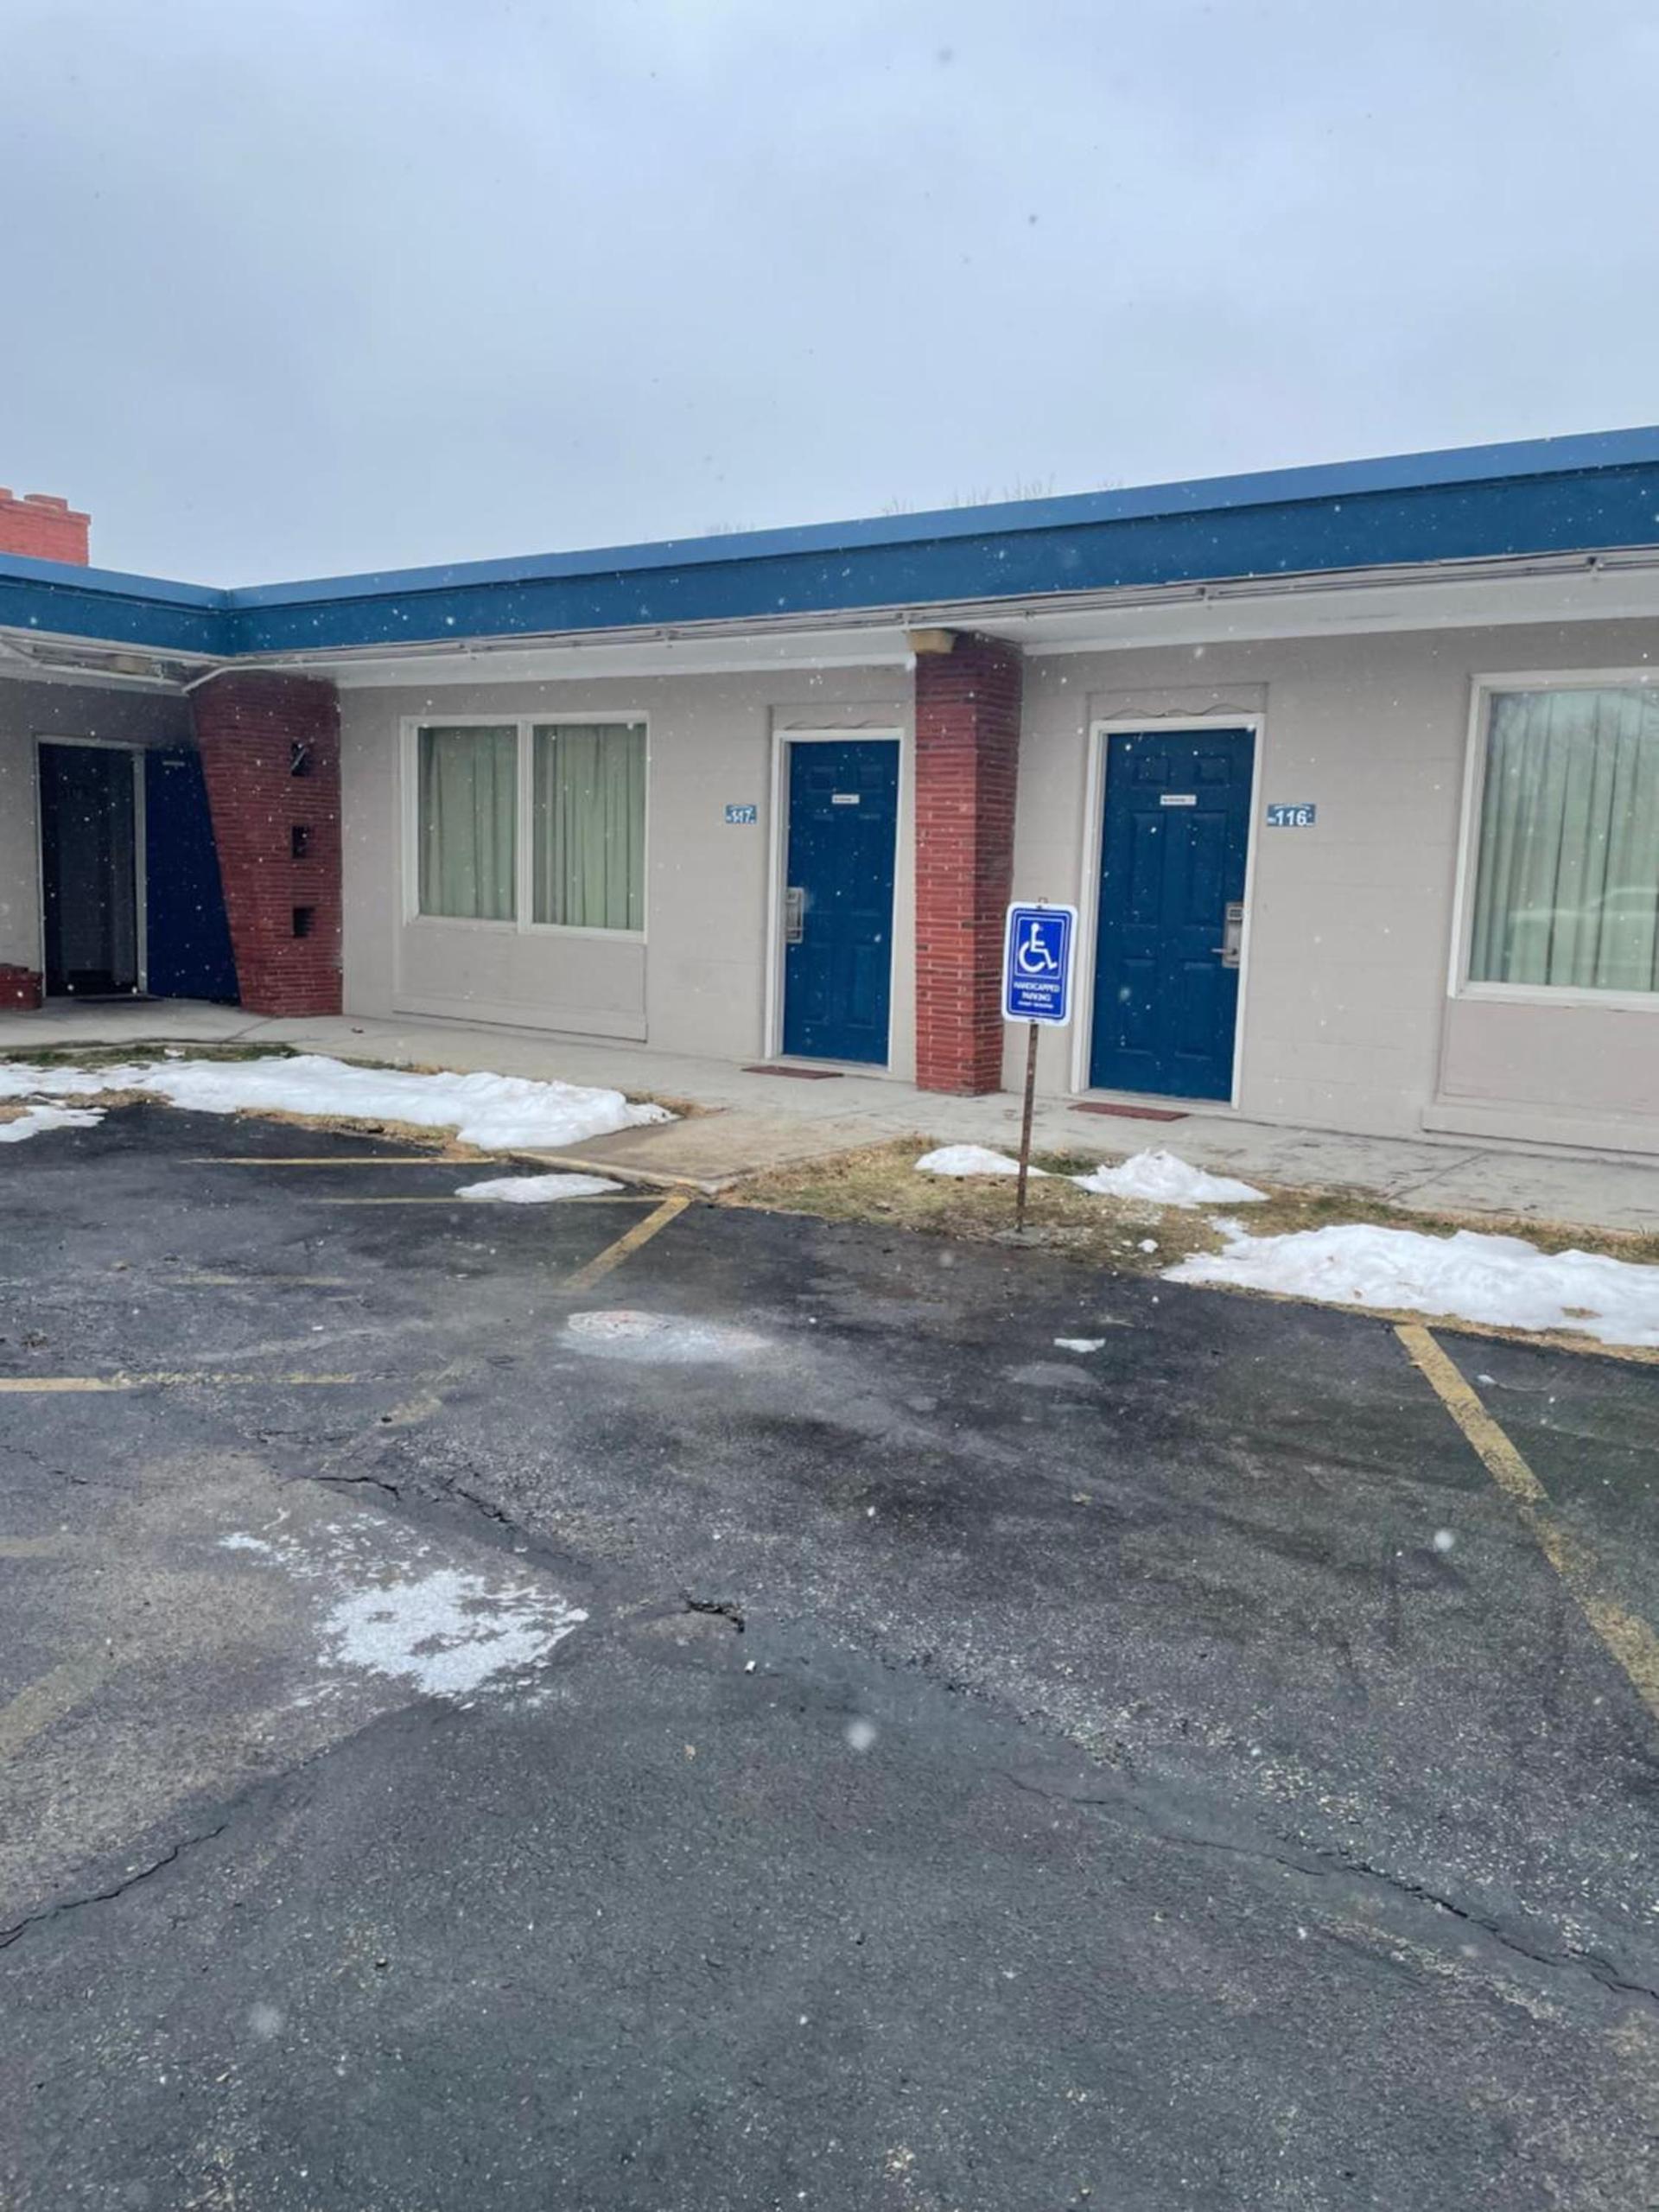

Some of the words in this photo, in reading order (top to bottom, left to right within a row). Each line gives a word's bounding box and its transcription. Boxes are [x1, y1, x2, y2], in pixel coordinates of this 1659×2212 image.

[1276, 810, 1306, 826] 116
[1013, 981, 1061, 993] HANDICAPPED
[1021, 991, 1052, 1001] PARKING
